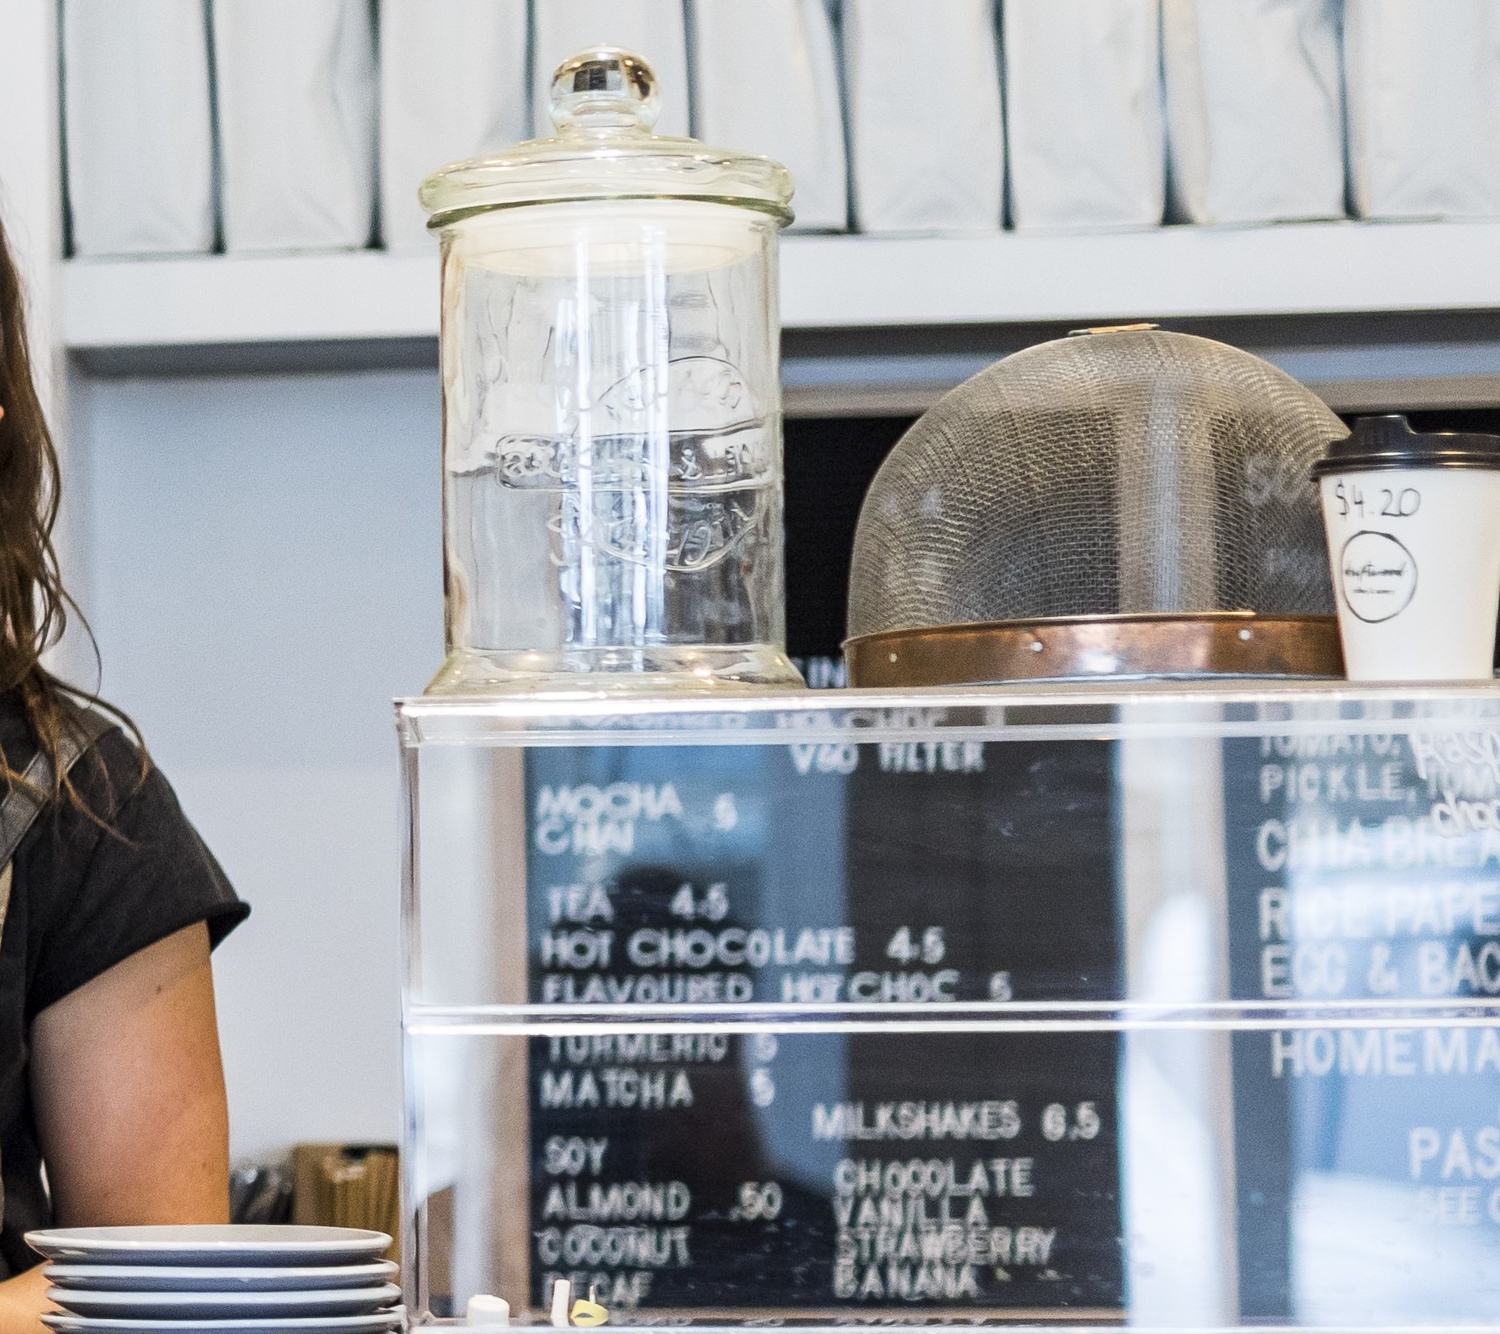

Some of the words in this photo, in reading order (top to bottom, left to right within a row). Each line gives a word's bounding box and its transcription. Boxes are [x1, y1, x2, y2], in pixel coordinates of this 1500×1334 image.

[1335, 478, 1421, 521] $4.20
[541, 928, 615, 968] HOT
[627, 925, 857, 969] CHOCOLATE
[542, 973, 754, 1003] FLAVOURED
[782, 972, 845, 1003] HOT
[850, 969, 961, 1003] CHOC
[540, 1067, 694, 1110] MATCHA
[812, 1100, 1022, 1141] MILKSHAKES
[544, 1135, 608, 1176] SOY
[833, 1157, 1035, 1197] CHOCOLATE
[544, 1181, 691, 1221] ALMOND
[834, 1195, 989, 1226] VANILLA
[536, 1224, 693, 1267] COCONUT
[835, 1225, 1057, 1265] STRAWBERRY
[834, 1263, 984, 1300] BANANA
